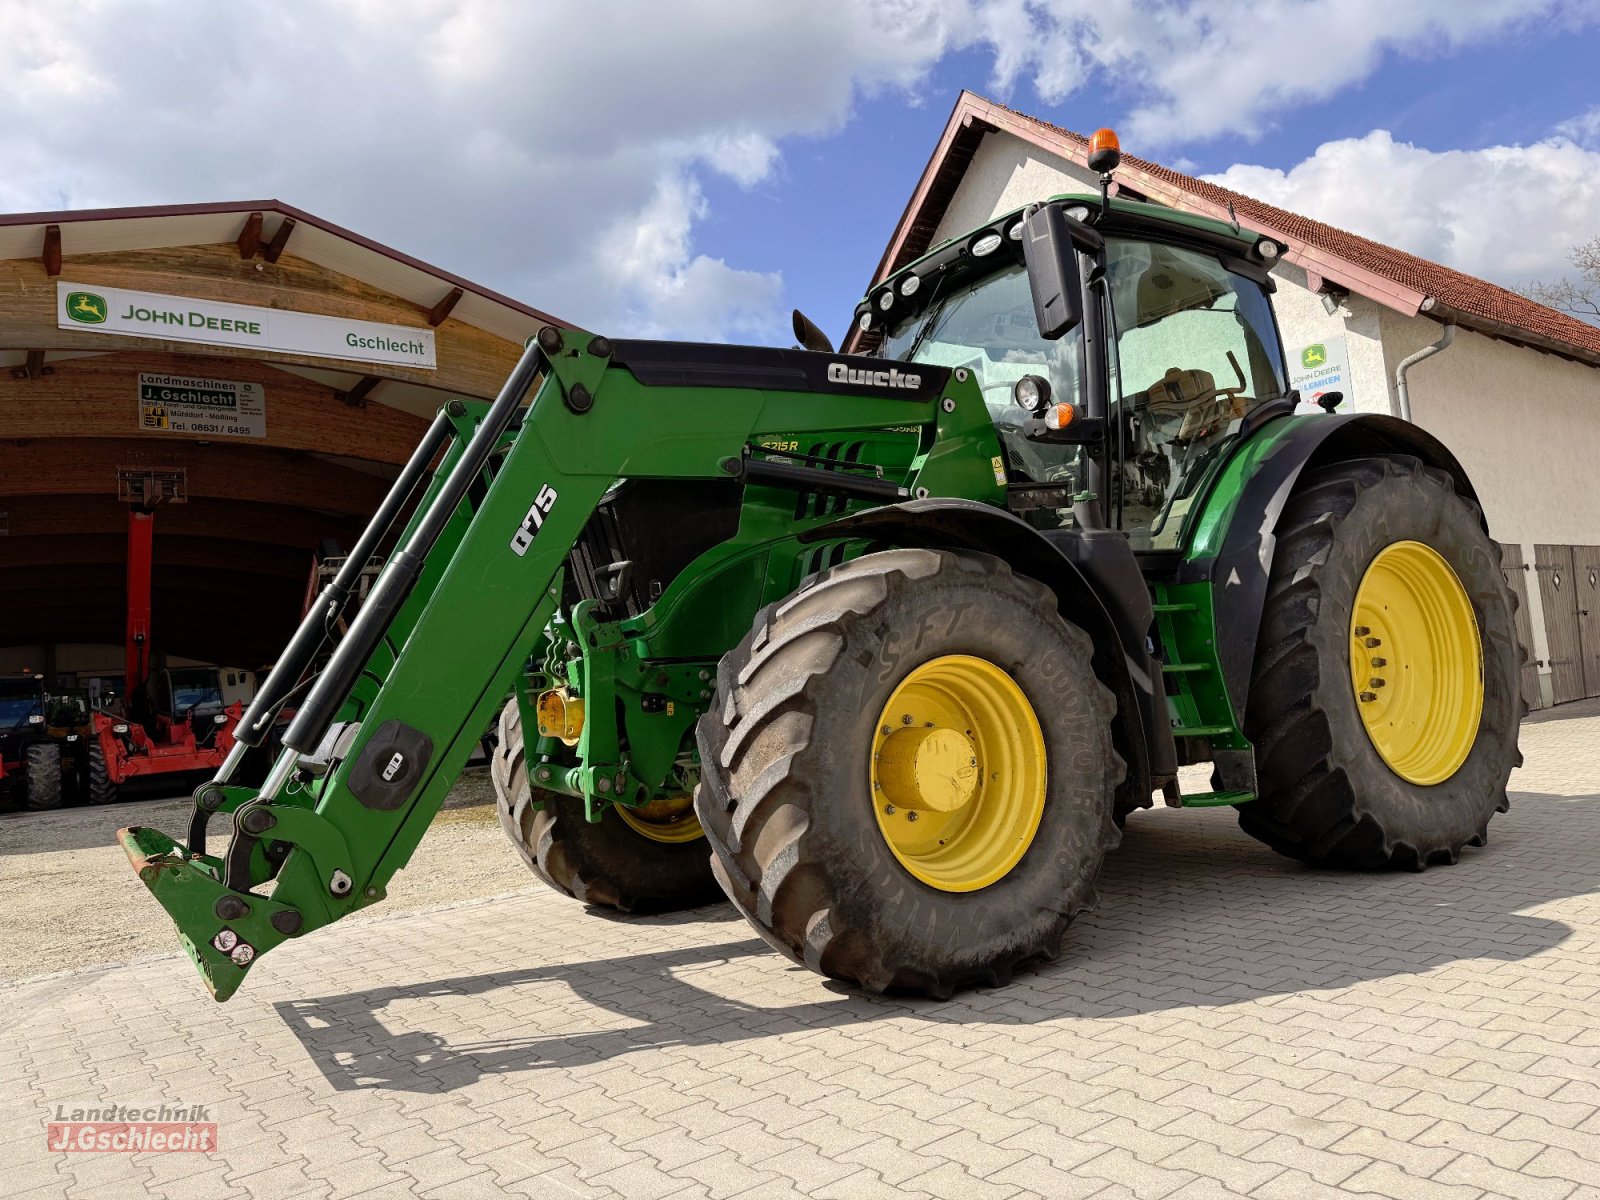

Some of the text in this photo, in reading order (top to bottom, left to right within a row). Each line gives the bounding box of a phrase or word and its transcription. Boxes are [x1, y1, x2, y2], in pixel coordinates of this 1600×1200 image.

[121, 304, 261, 335] JOHN DEERE
[346, 333, 425, 355] Gschlecht
[140, 374, 236, 391] Landmaschinen
[827, 362, 922, 389] Quicke
[1291, 365, 1341, 385] JOHN DEERE
[1303, 375, 1340, 391] LEMKEN
[145, 388, 234, 405] J. Gschlecht
[170, 410, 204, 419] Mühldorf
[171, 422, 188, 431] Tel.
[227, 426, 251, 435] 6495
